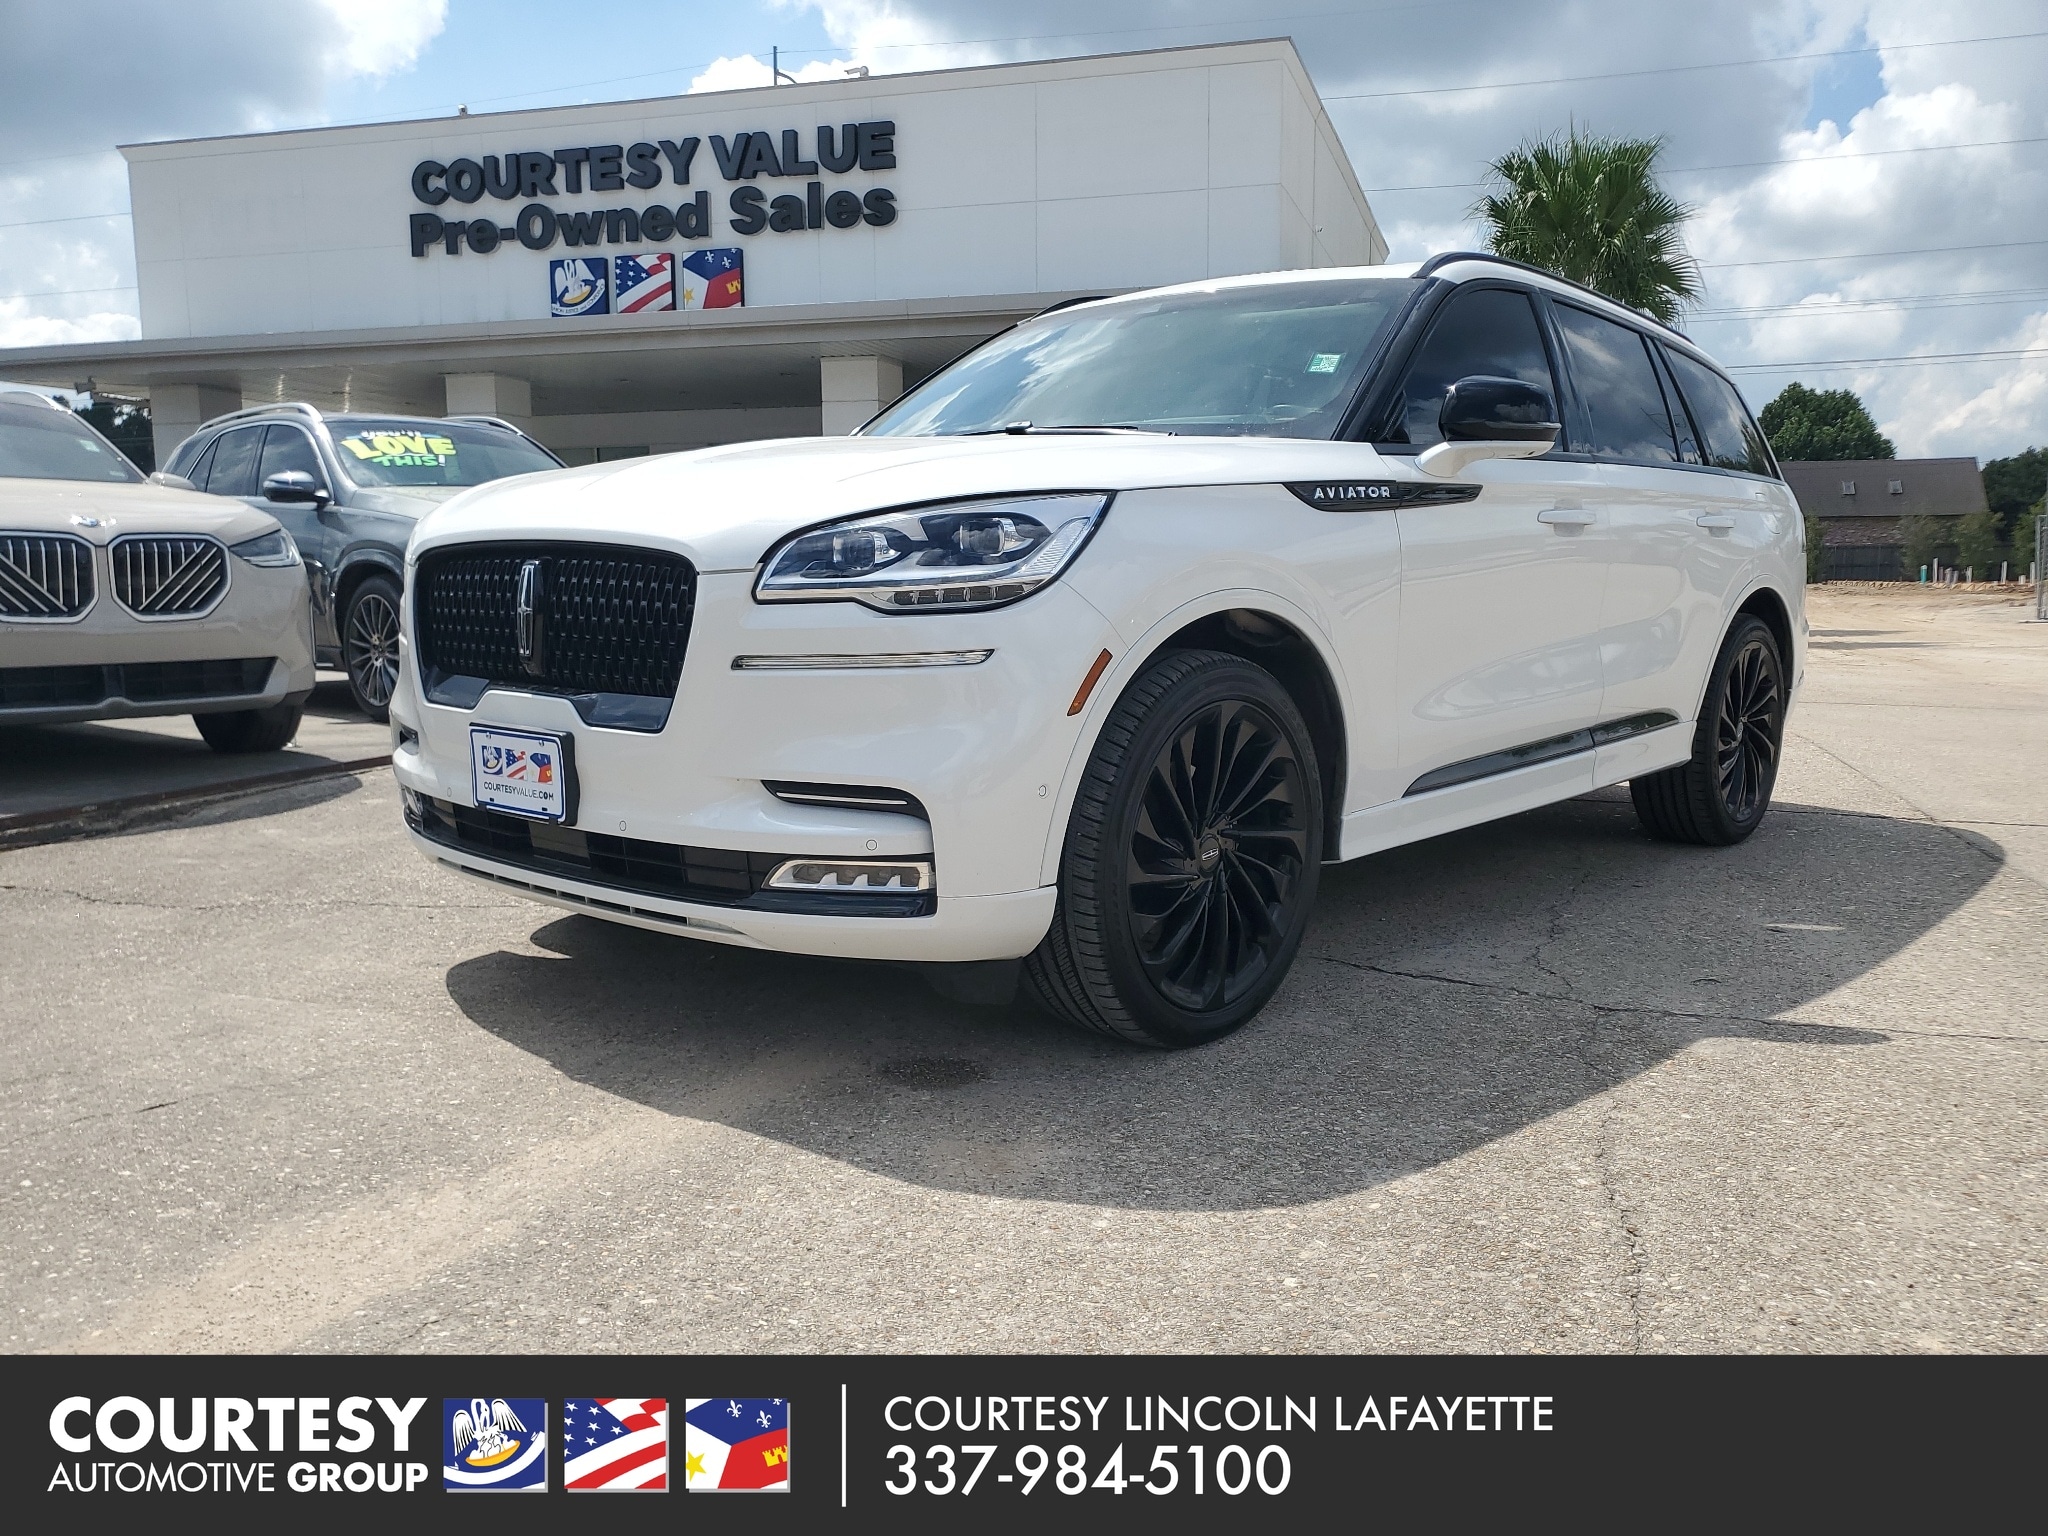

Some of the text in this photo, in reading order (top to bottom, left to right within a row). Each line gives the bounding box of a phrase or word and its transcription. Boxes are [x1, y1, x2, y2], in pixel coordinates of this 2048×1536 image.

[412, 121, 896, 205] COURTESY VALUE
[409, 182, 897, 258] Pre-Owned Sales
[341, 435, 456, 460] LOVE
[372, 454, 445, 467] THIS!
[1314, 486, 1390, 499] AVIATOR
[483, 782, 554, 801] COURTESYVALUE.COM
